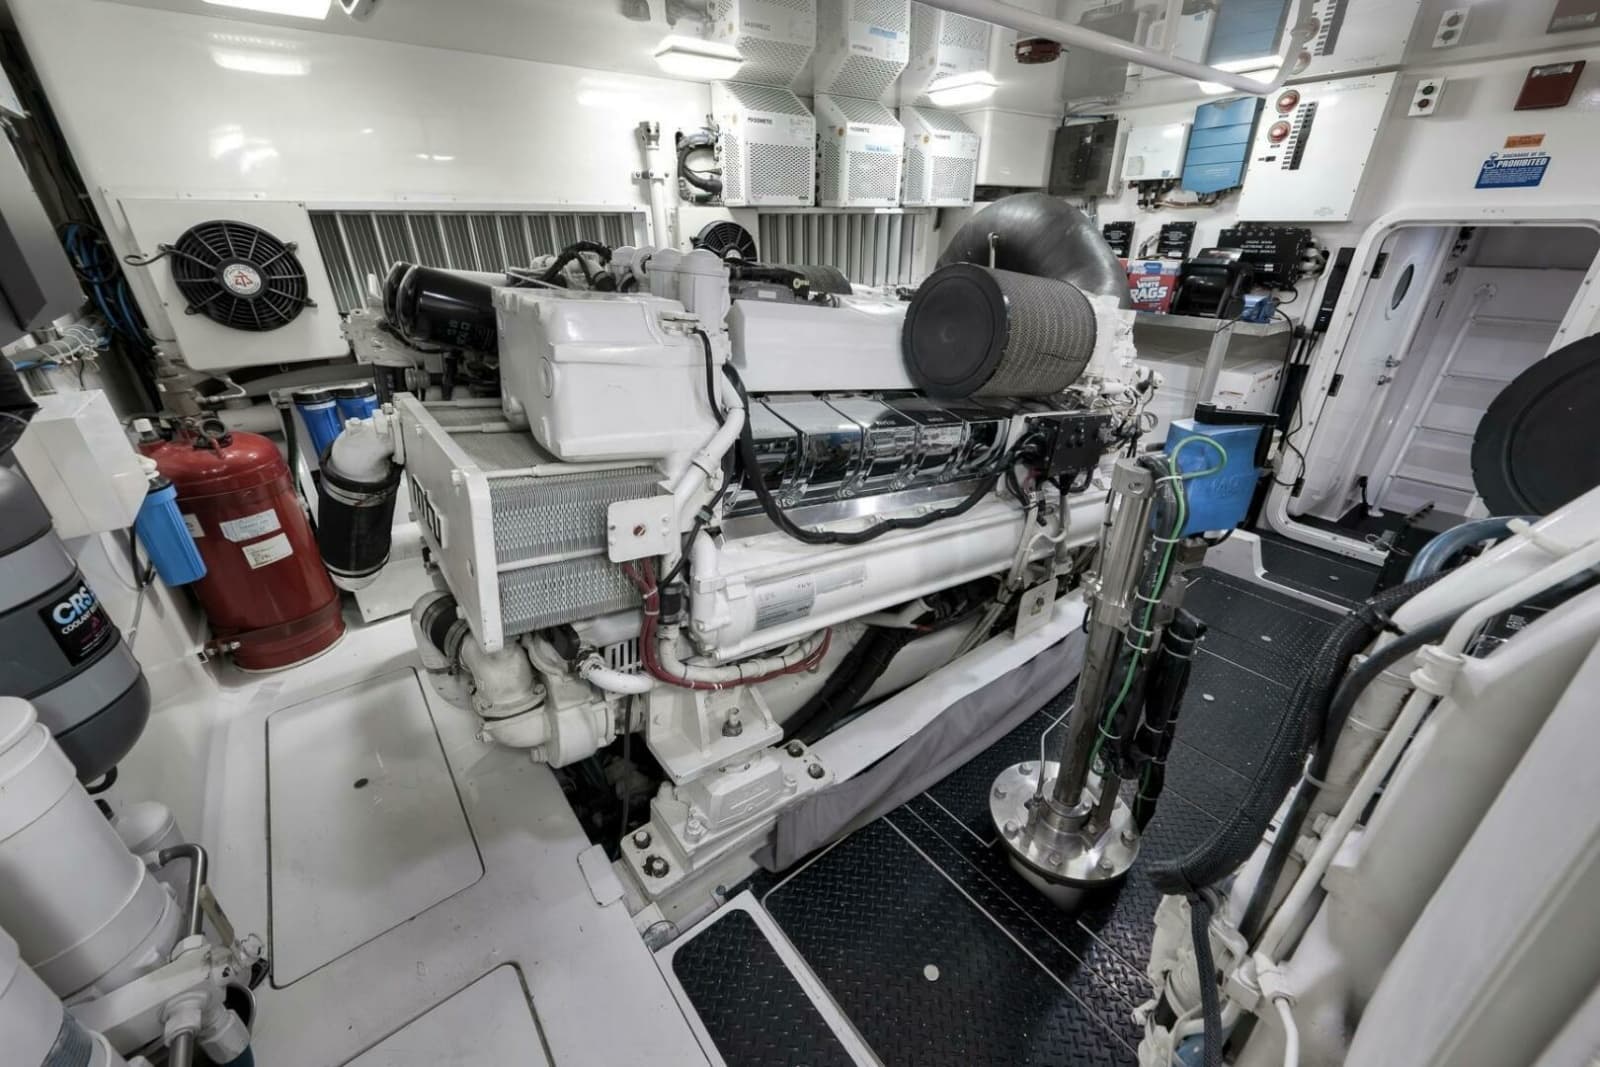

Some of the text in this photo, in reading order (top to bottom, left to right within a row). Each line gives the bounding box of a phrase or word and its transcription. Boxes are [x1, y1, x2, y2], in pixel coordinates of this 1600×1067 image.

[1496, 157, 1548, 168] PROHIBITED
[1136, 280, 1160, 289] WHITE
[1130, 286, 1168, 304] RAGS
